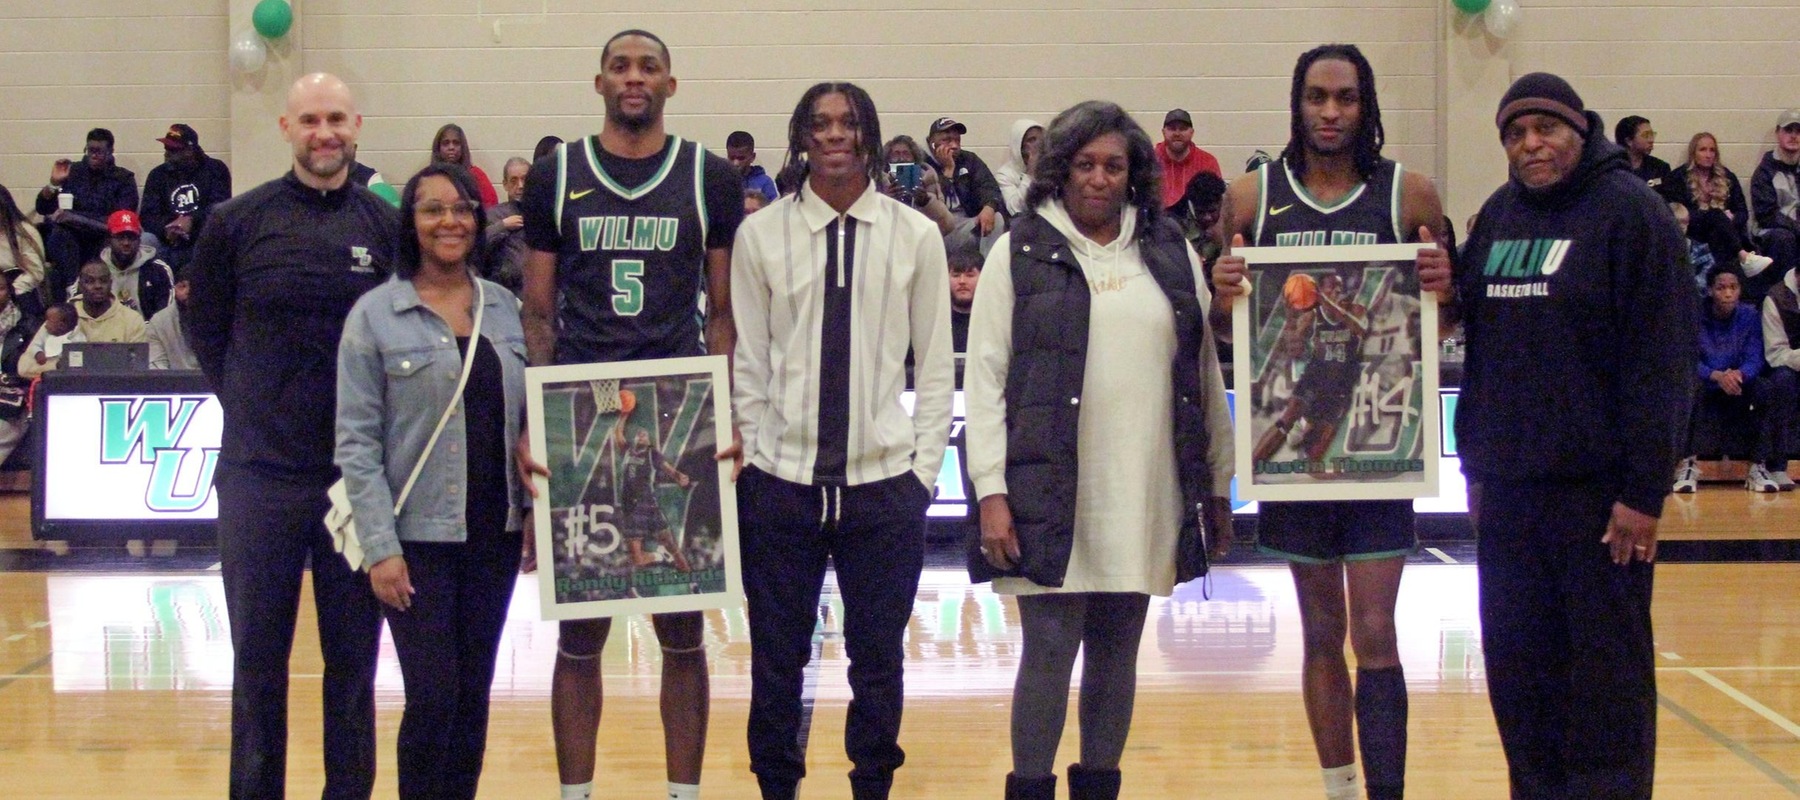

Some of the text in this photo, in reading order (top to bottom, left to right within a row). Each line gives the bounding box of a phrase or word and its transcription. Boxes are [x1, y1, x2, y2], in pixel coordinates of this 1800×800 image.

[579, 216, 679, 251] WILMU
[611, 259, 645, 316] 5
[1350, 371, 1419, 428] #14
[1254, 456, 1424, 475] Justin Thomas
[564, 503, 620, 558] #5
[556, 574, 627, 594] Randy
